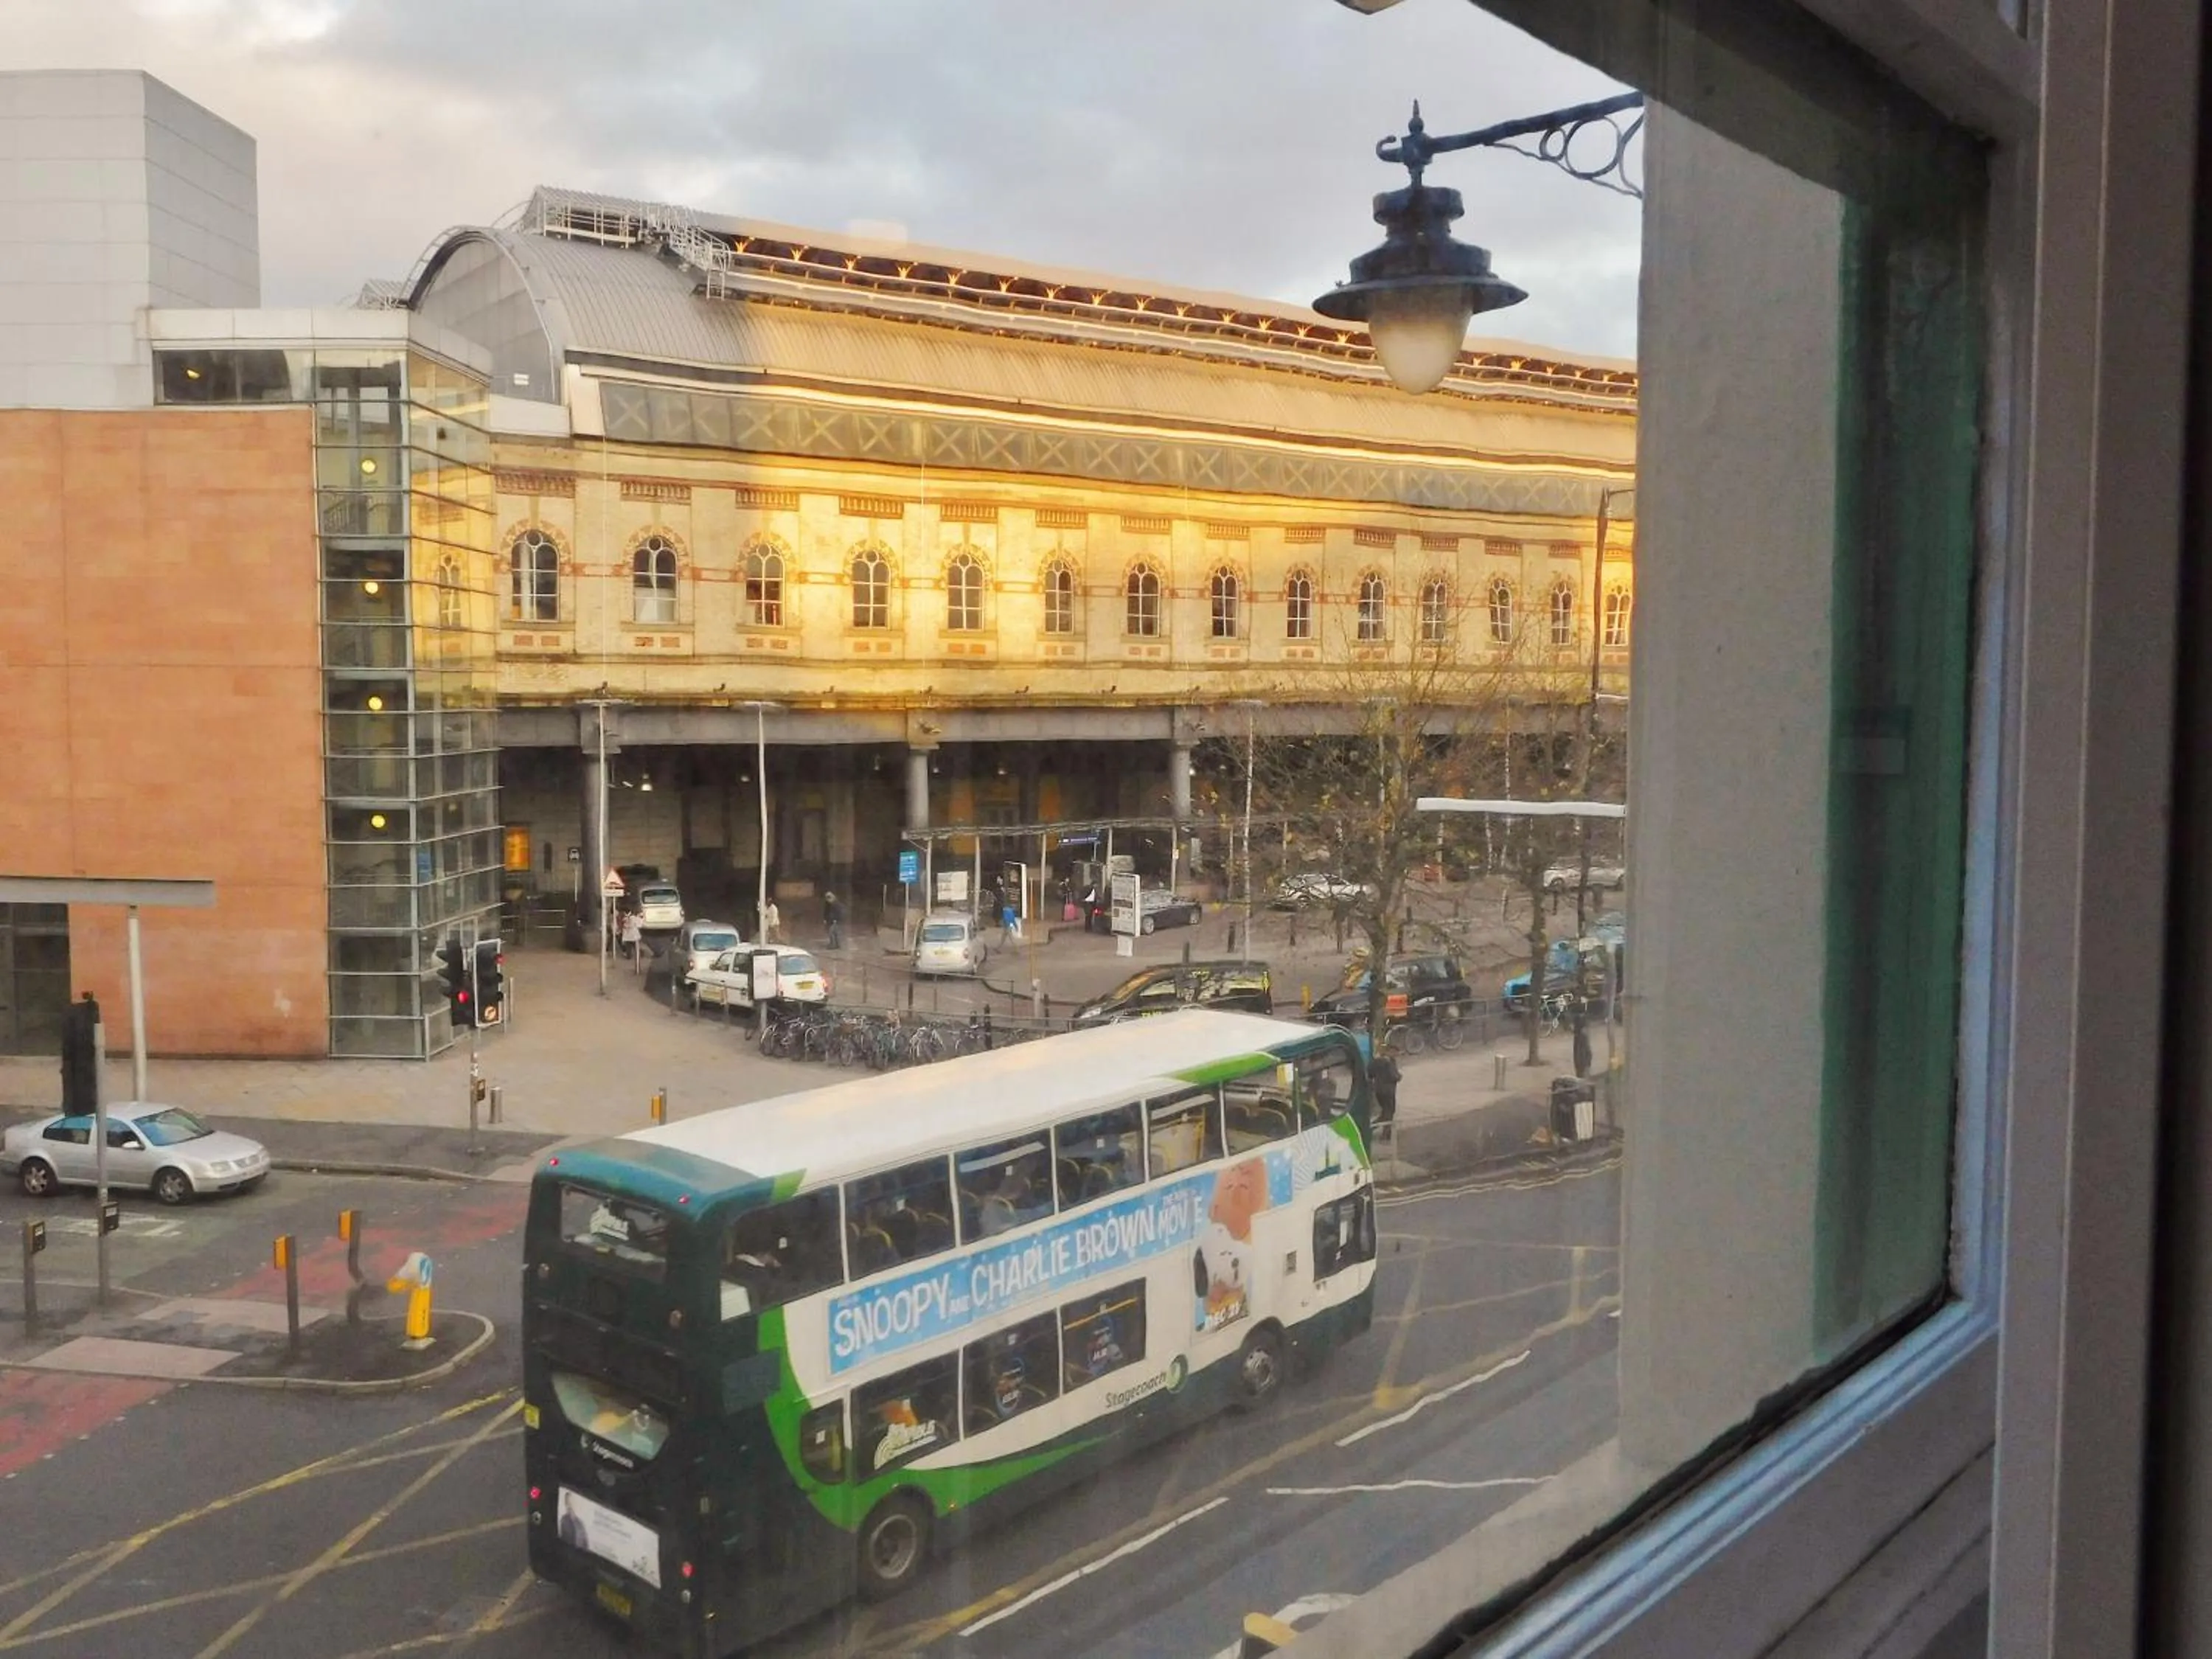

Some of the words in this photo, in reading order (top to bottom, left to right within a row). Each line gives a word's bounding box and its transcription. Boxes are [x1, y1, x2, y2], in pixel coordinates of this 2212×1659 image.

[834, 1273, 950, 1357] SNOOPY
[971, 1235, 1071, 1307] CHARLIE
[1076, 1205, 1155, 1265] BROWN
